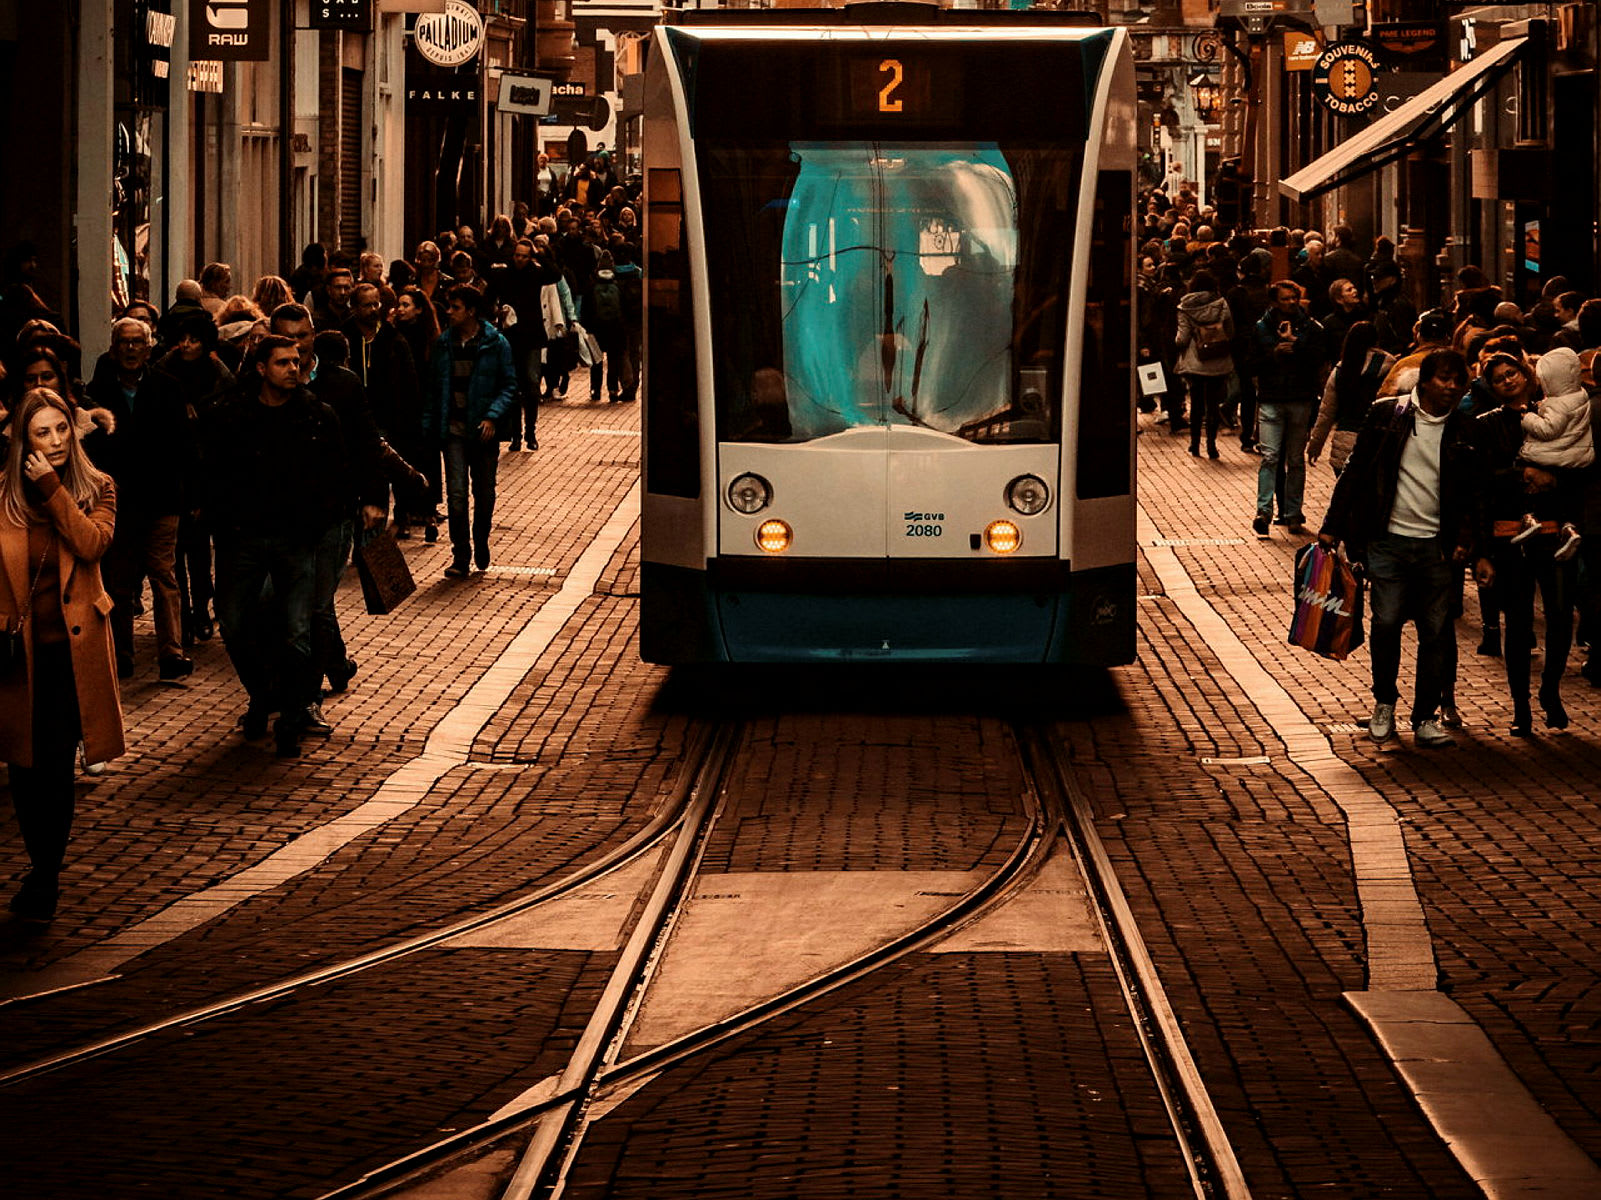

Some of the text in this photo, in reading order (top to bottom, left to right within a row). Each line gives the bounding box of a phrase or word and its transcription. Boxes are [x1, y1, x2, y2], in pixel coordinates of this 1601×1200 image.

[208, 33, 249, 46] RAW
[419, 14, 478, 52] PALLADIUM
[879, 59, 903, 111] 2
[408, 90, 476, 100] FALKE
[1324, 92, 1379, 113] TOBACCO
[923, 513, 945, 521] GVB
[906, 524, 942, 537] 2080
